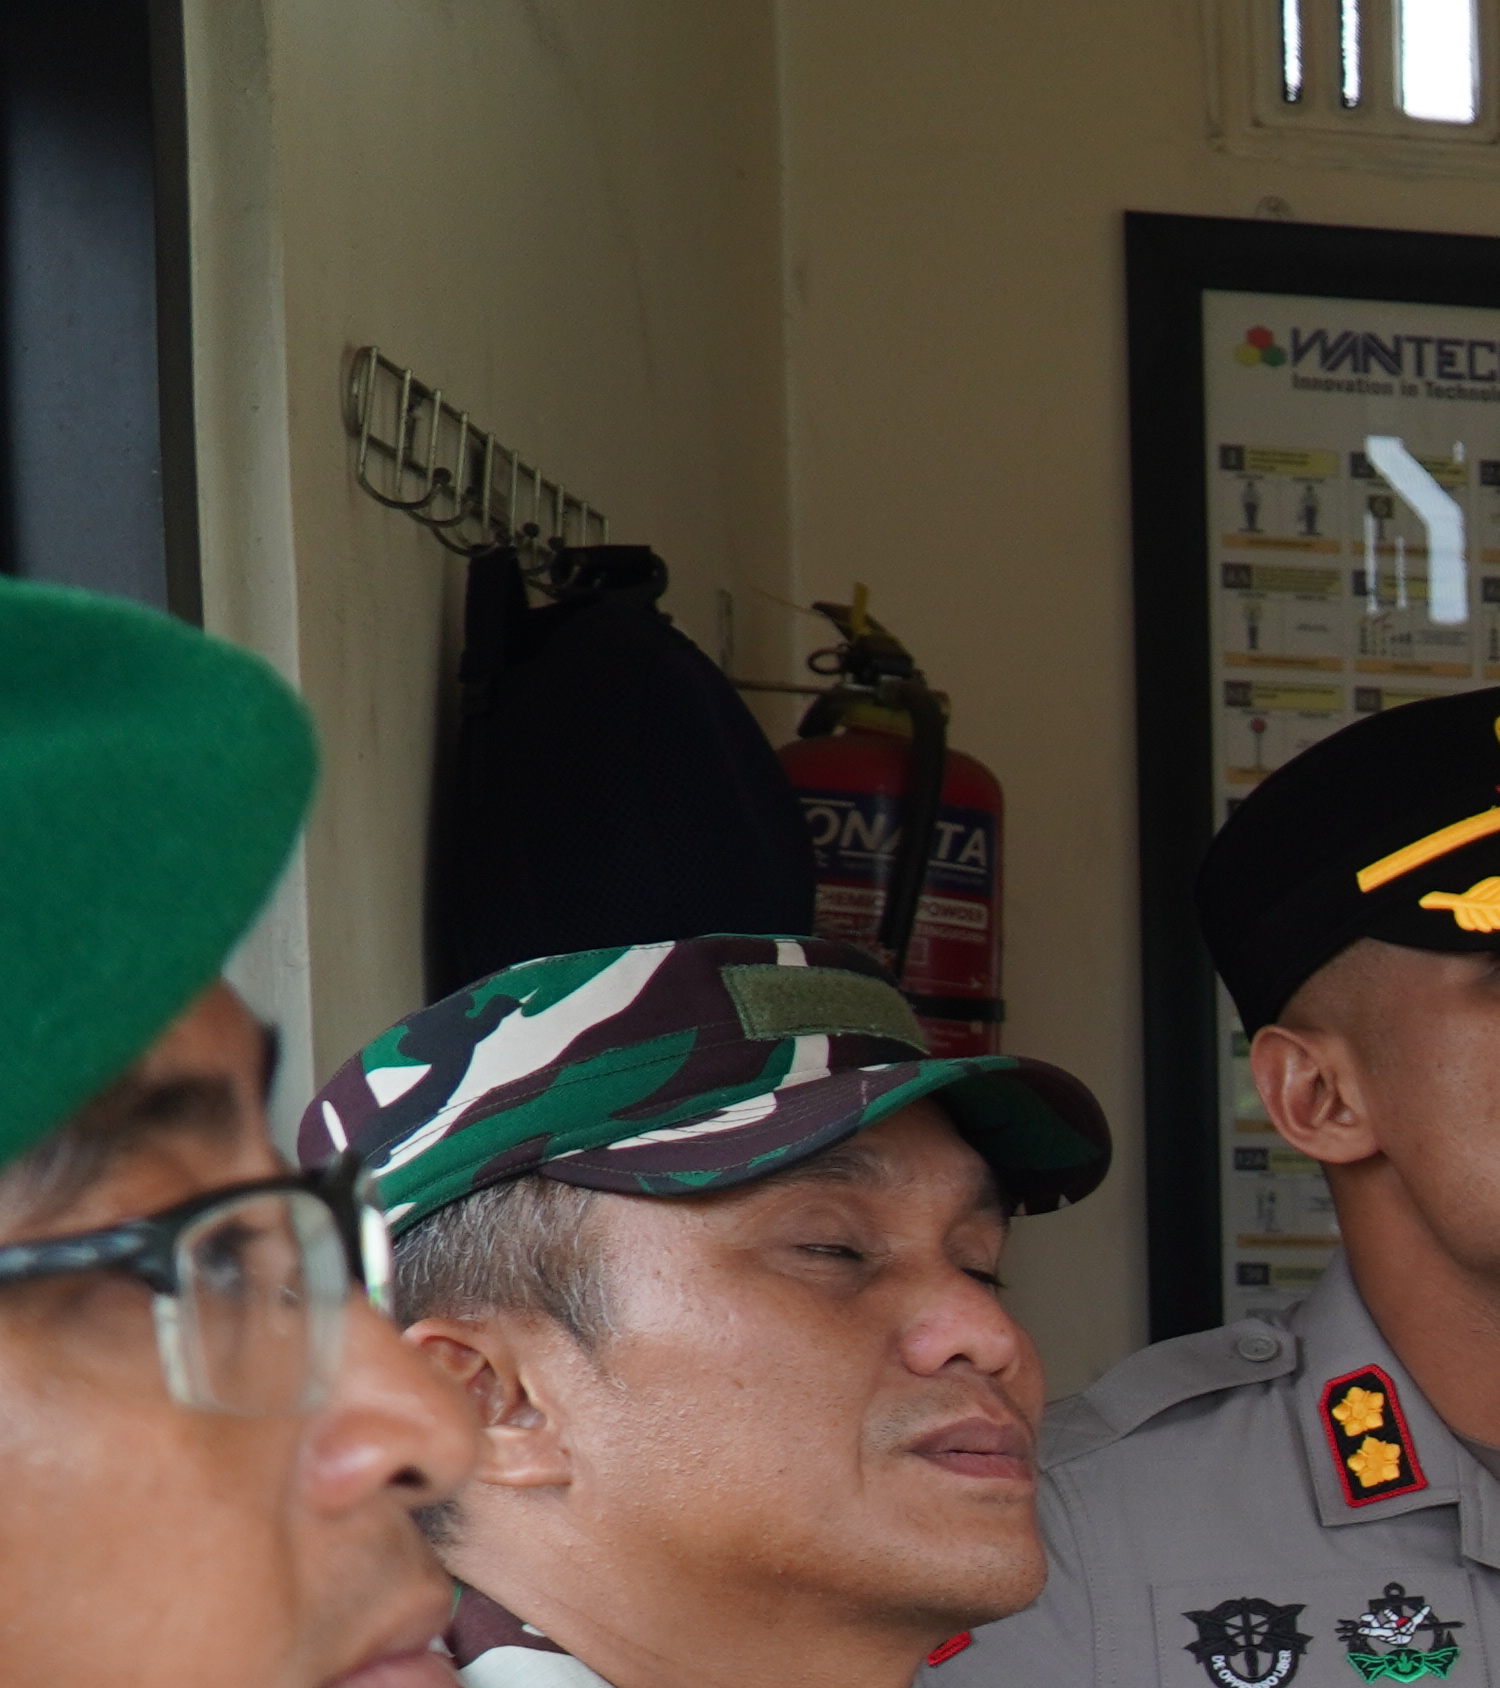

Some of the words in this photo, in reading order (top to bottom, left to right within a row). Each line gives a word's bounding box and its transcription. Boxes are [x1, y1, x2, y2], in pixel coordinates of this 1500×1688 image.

[1292, 372, 1393, 396] Innovation
[1401, 381, 1418, 397] in
[1210, 1653, 1226, 1671] DE
